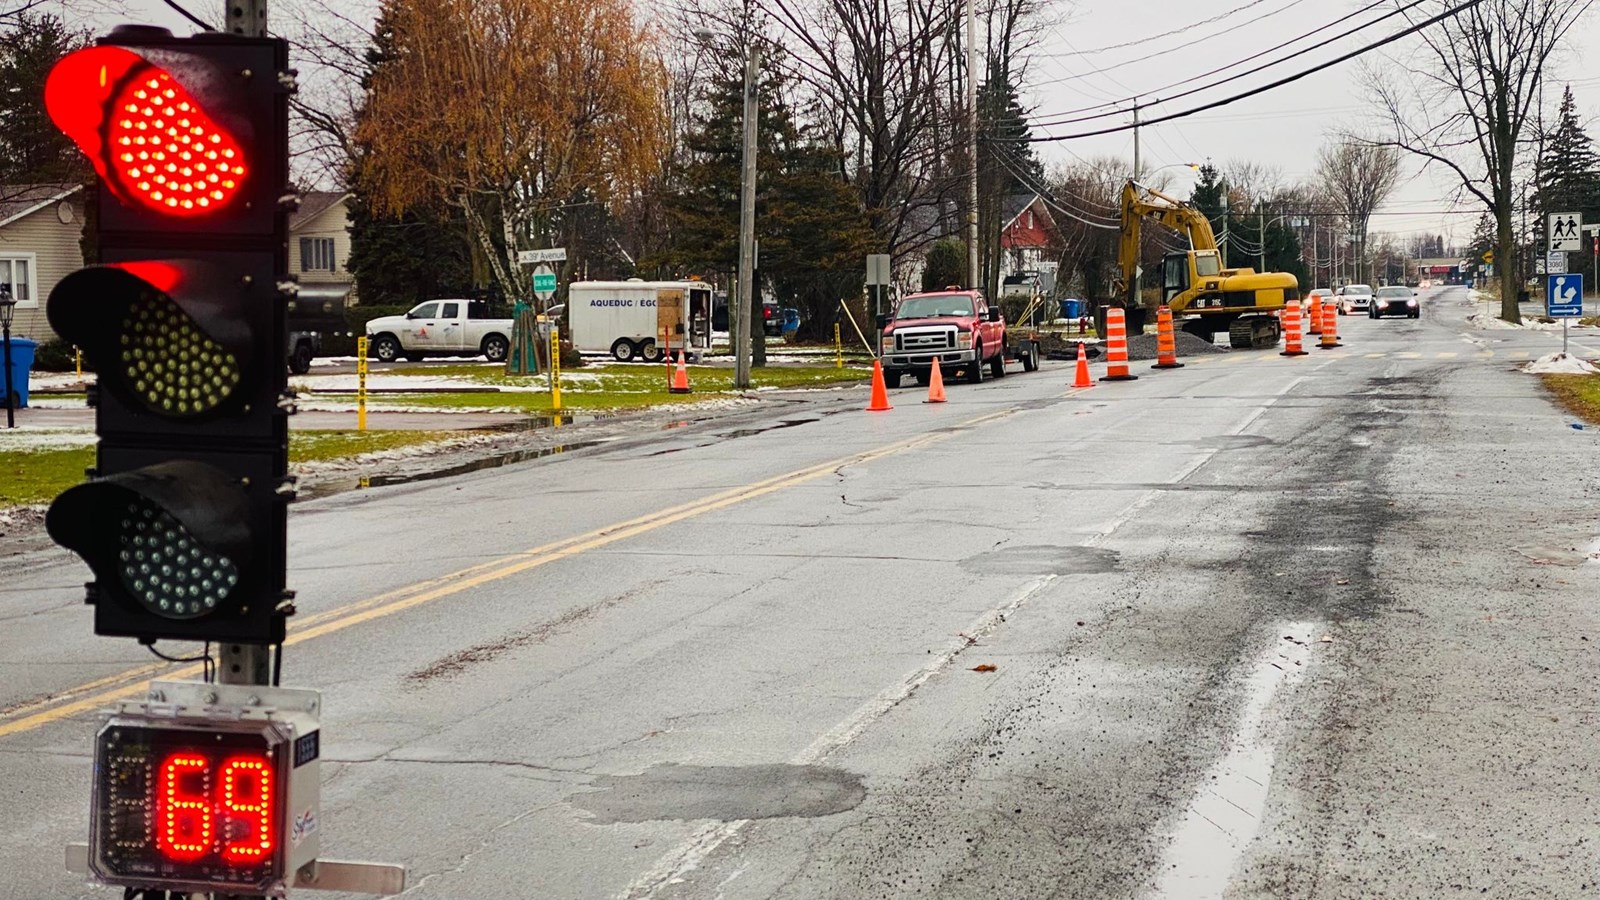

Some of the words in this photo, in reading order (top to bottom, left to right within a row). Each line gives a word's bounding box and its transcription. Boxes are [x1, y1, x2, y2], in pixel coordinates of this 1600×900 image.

[541, 251, 565, 260] Avenue
[590, 299, 633, 307] AQUEDUC
[1197, 299, 1206, 308] CAT
[165, 755, 271, 857] 69
